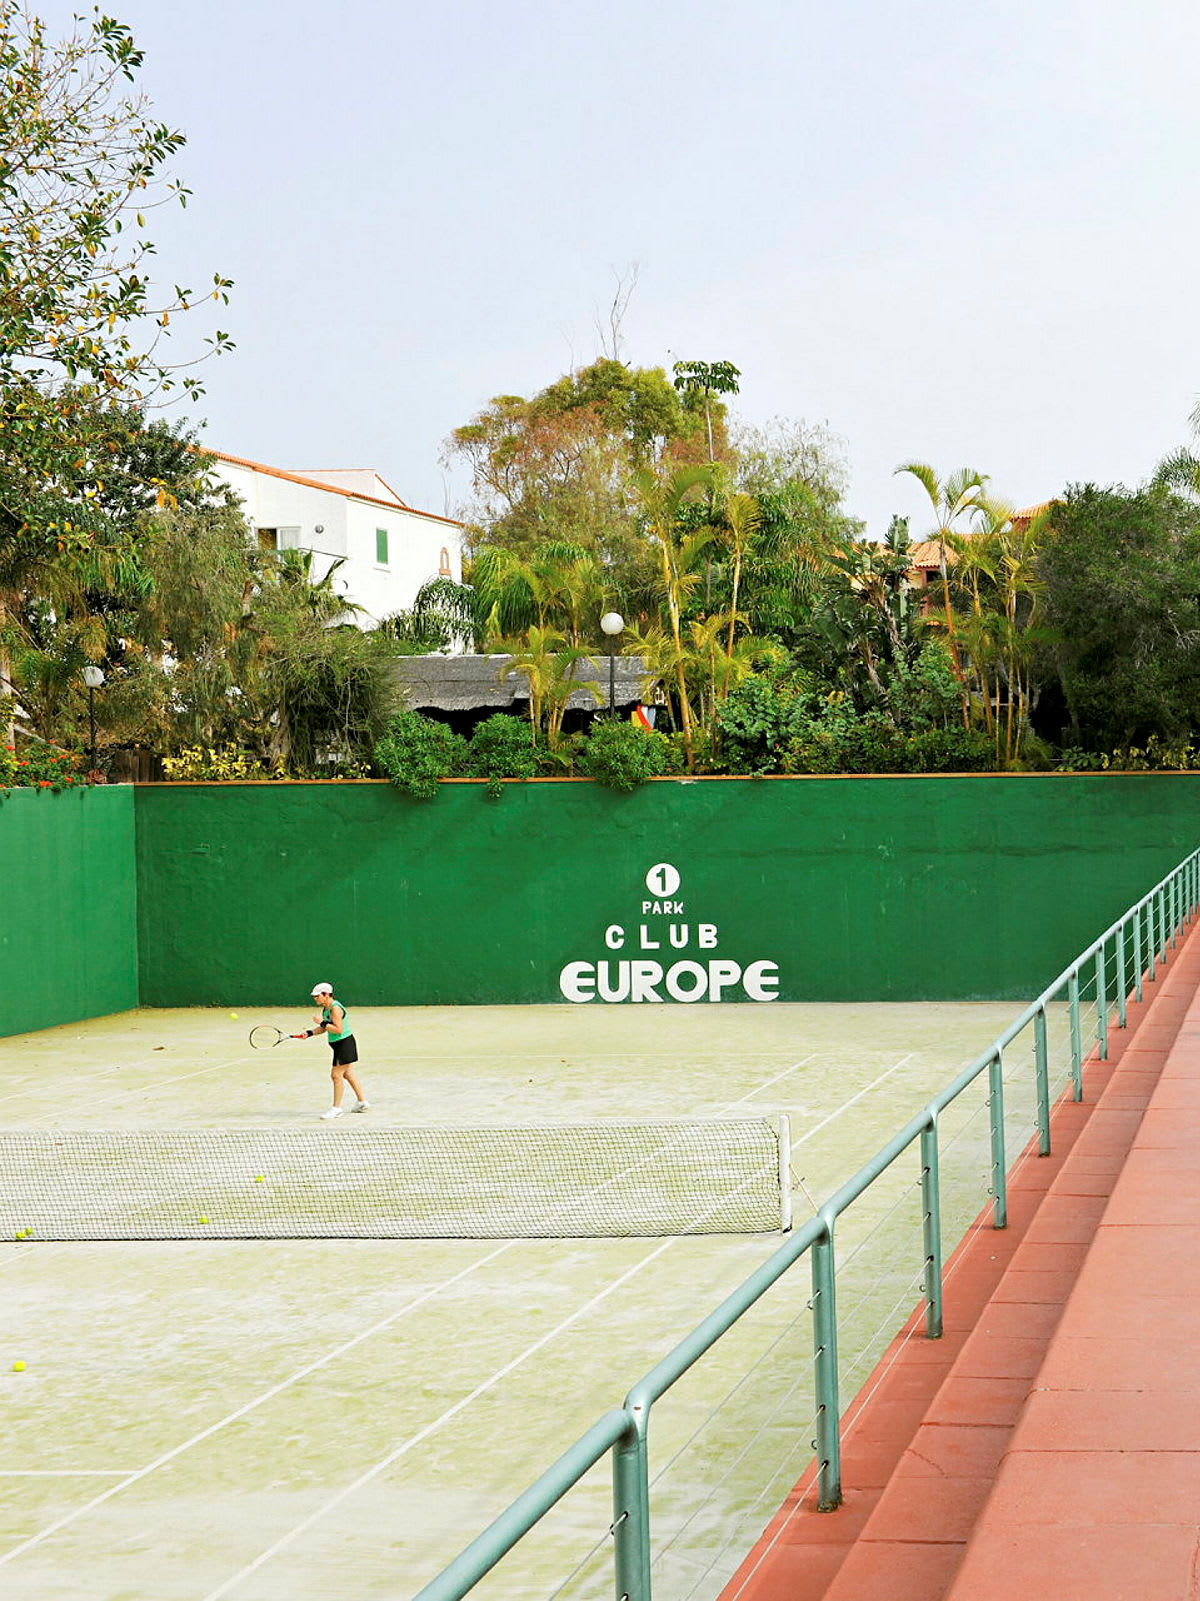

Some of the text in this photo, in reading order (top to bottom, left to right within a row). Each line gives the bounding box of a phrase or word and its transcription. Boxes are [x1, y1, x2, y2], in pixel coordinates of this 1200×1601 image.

[655, 867, 667, 892] 1
[642, 901, 683, 915] PARK
[605, 923, 718, 949] CLUB
[559, 959, 780, 1003] EUROPE
